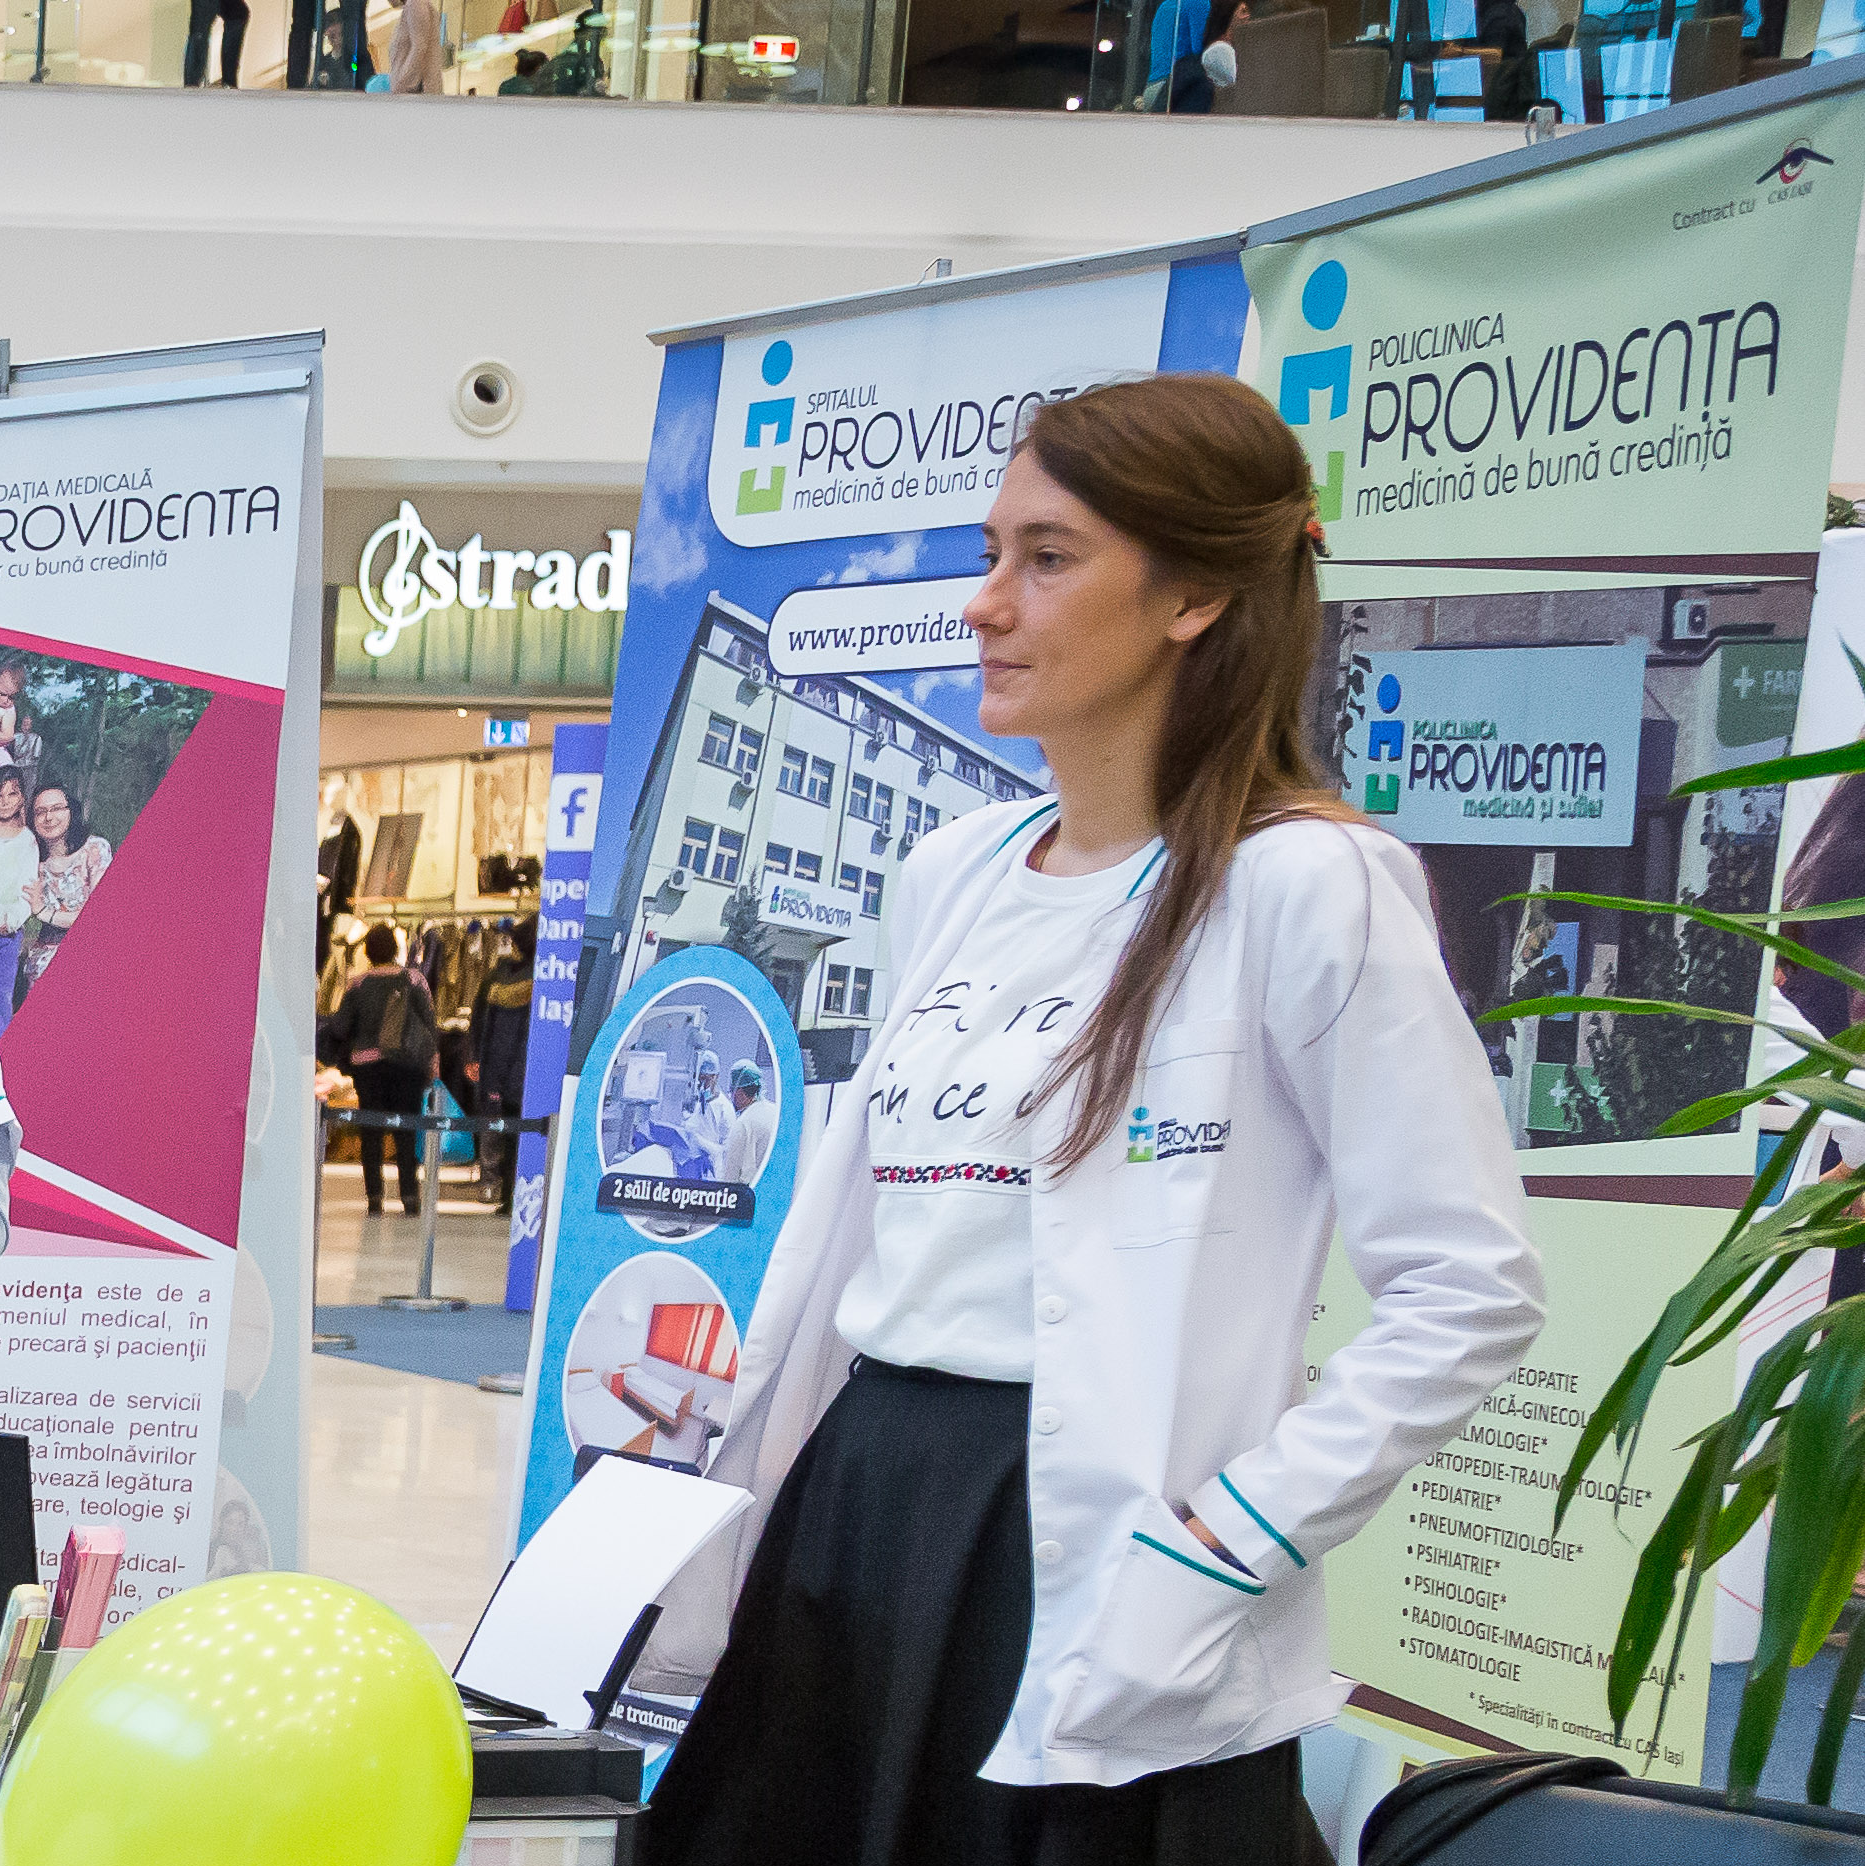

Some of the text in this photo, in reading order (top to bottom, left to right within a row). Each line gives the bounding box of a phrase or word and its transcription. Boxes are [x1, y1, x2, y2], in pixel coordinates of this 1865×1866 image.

[1672, 201, 1735, 230] Contract
[1368, 312, 1505, 371] POLICLINICA
[806, 385, 879, 415] SPITALUL
[55, 468, 153, 498] MEDICALĂ
[793, 476, 884, 511] medicină
[891, 472, 919, 501] de
[925, 467, 978, 497] bună
[1356, 462, 1476, 517] medicină
[1484, 454, 1518, 496] de
[1527, 440, 1600, 491] bună
[7, 561, 29, 577] cu
[36, 554, 84, 577] bună
[788, 611, 975, 655] www.providen
[1412, 719, 1498, 740] POLICLINICA
[613, 1179, 623, 1198] 2
[653, 1181, 671, 1203] de
[97, 1283, 142, 1301] este
[157, 1284, 183, 1303] de
[198, 1288, 211, 1304] a
[81, 1310, 172, 1331] medical,
[189, 1312, 208, 1331] în
[9, 1335, 87, 1356] precară
[89, 1390, 115, 1408] de
[127, 1393, 202, 1412] servicii
[129, 1421, 199, 1440] pentru
[54, 1441, 197, 1466] îmbolnăvirilor
[30, 1470, 193, 1495] ovează legătura
[80, 1497, 165, 1523] teologie
[1409, 1637, 1522, 1683] STOMATOLOGIE
[626, 1704, 690, 1735] tratame
